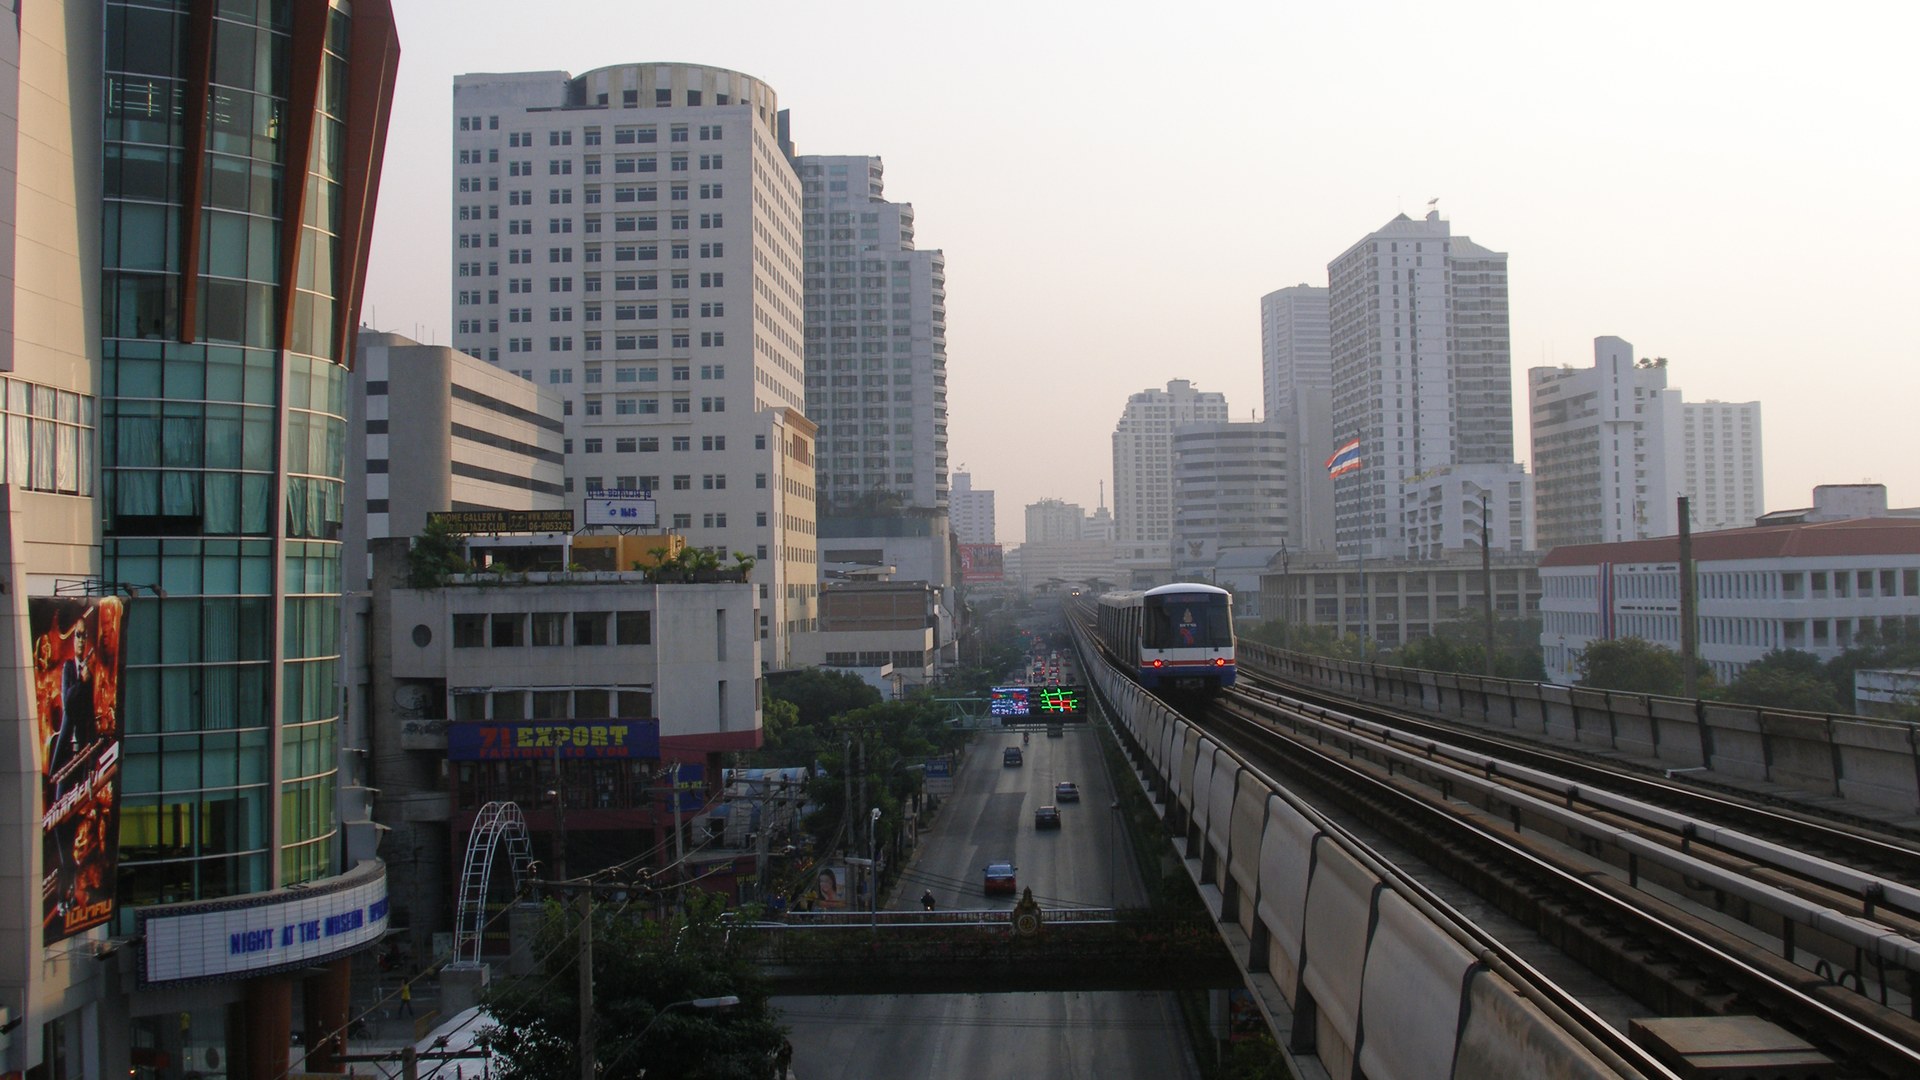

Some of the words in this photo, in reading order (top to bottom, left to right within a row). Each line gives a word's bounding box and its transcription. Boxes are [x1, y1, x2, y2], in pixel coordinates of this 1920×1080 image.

[463, 512, 496, 521] GALLERY
[469, 522, 487, 532] JAZZ
[488, 521, 507, 532] CLUB
[517, 725, 629, 747] EXPORT
[230, 928, 274, 955] NIGHT
[281, 925, 295, 947] AT
[299, 920, 320, 943] THE
